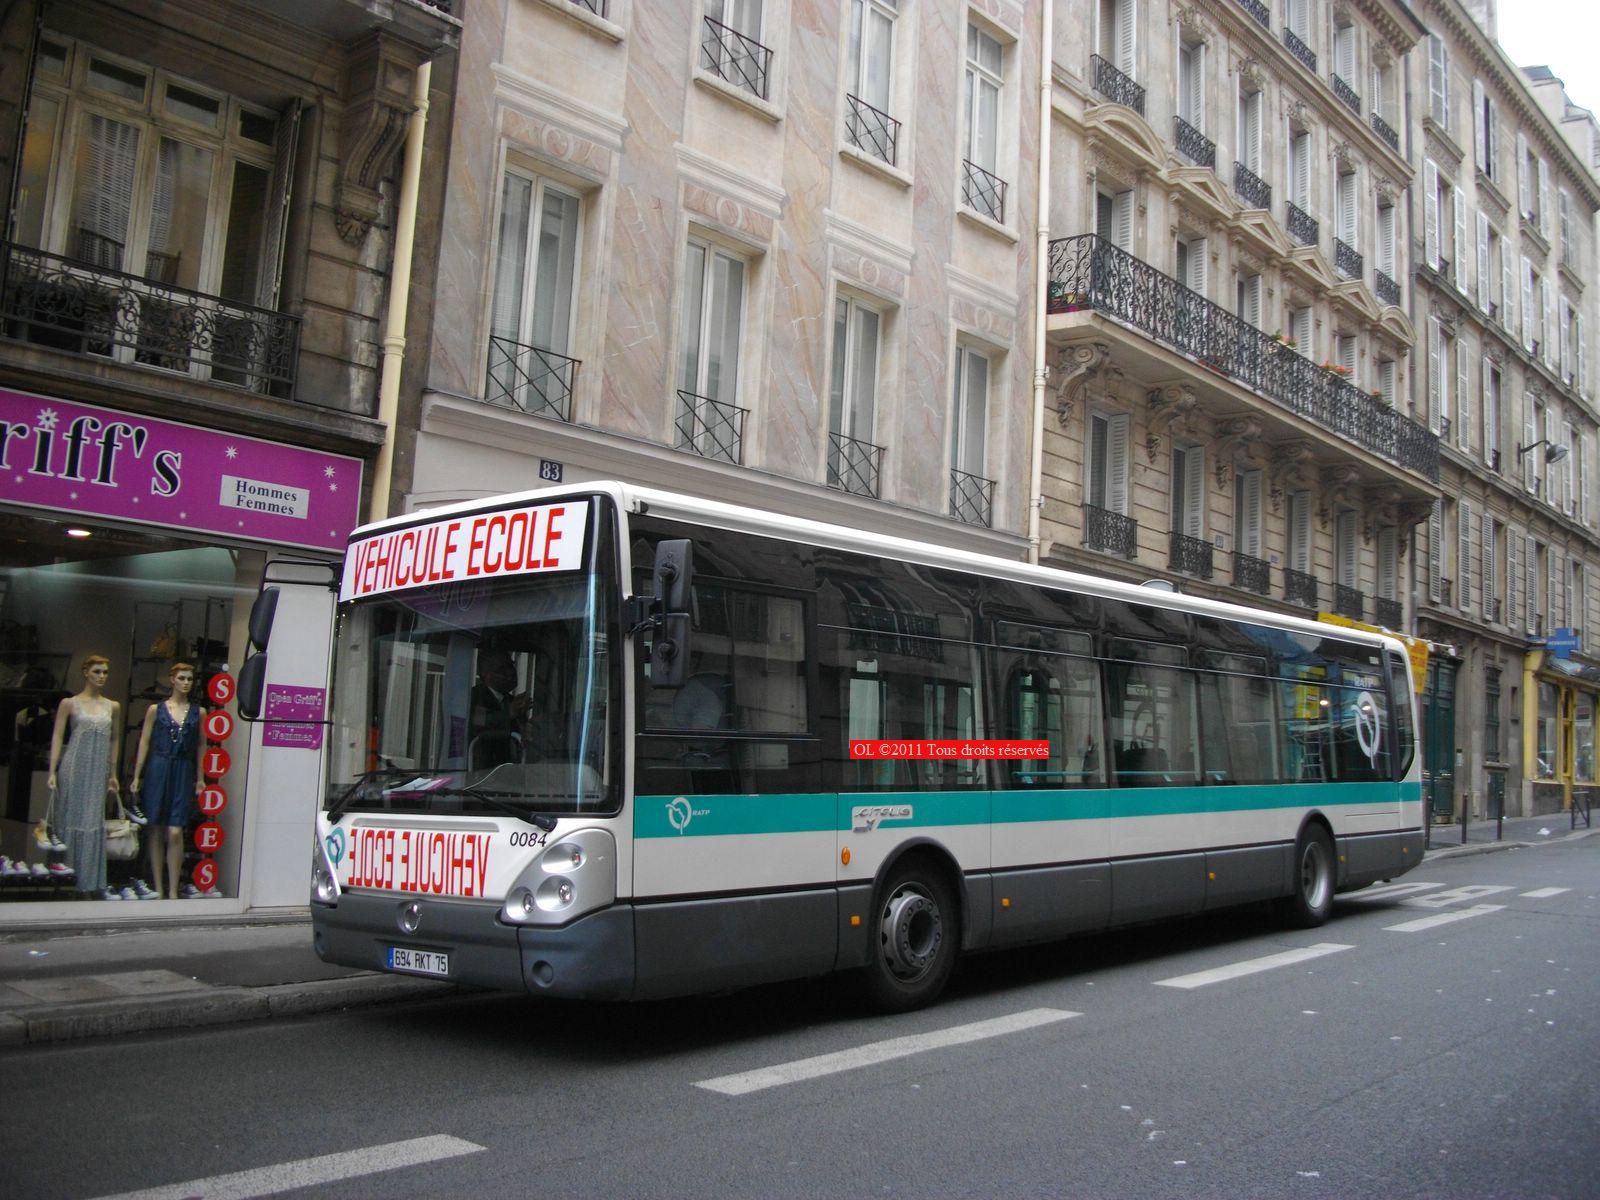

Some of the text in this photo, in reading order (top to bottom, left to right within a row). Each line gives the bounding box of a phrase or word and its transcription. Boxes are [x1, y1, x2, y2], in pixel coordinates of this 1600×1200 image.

[542, 461, 560, 480] 83
[236, 479, 297, 502] Hommes
[235, 495, 295, 515] Femmes
[353, 507, 565, 596] VEHICULE ECOLE
[199, 677, 232, 886] SOLDES
[510, 831, 548, 847] 0084
[395, 950, 447, 972] 694 RKT 75
